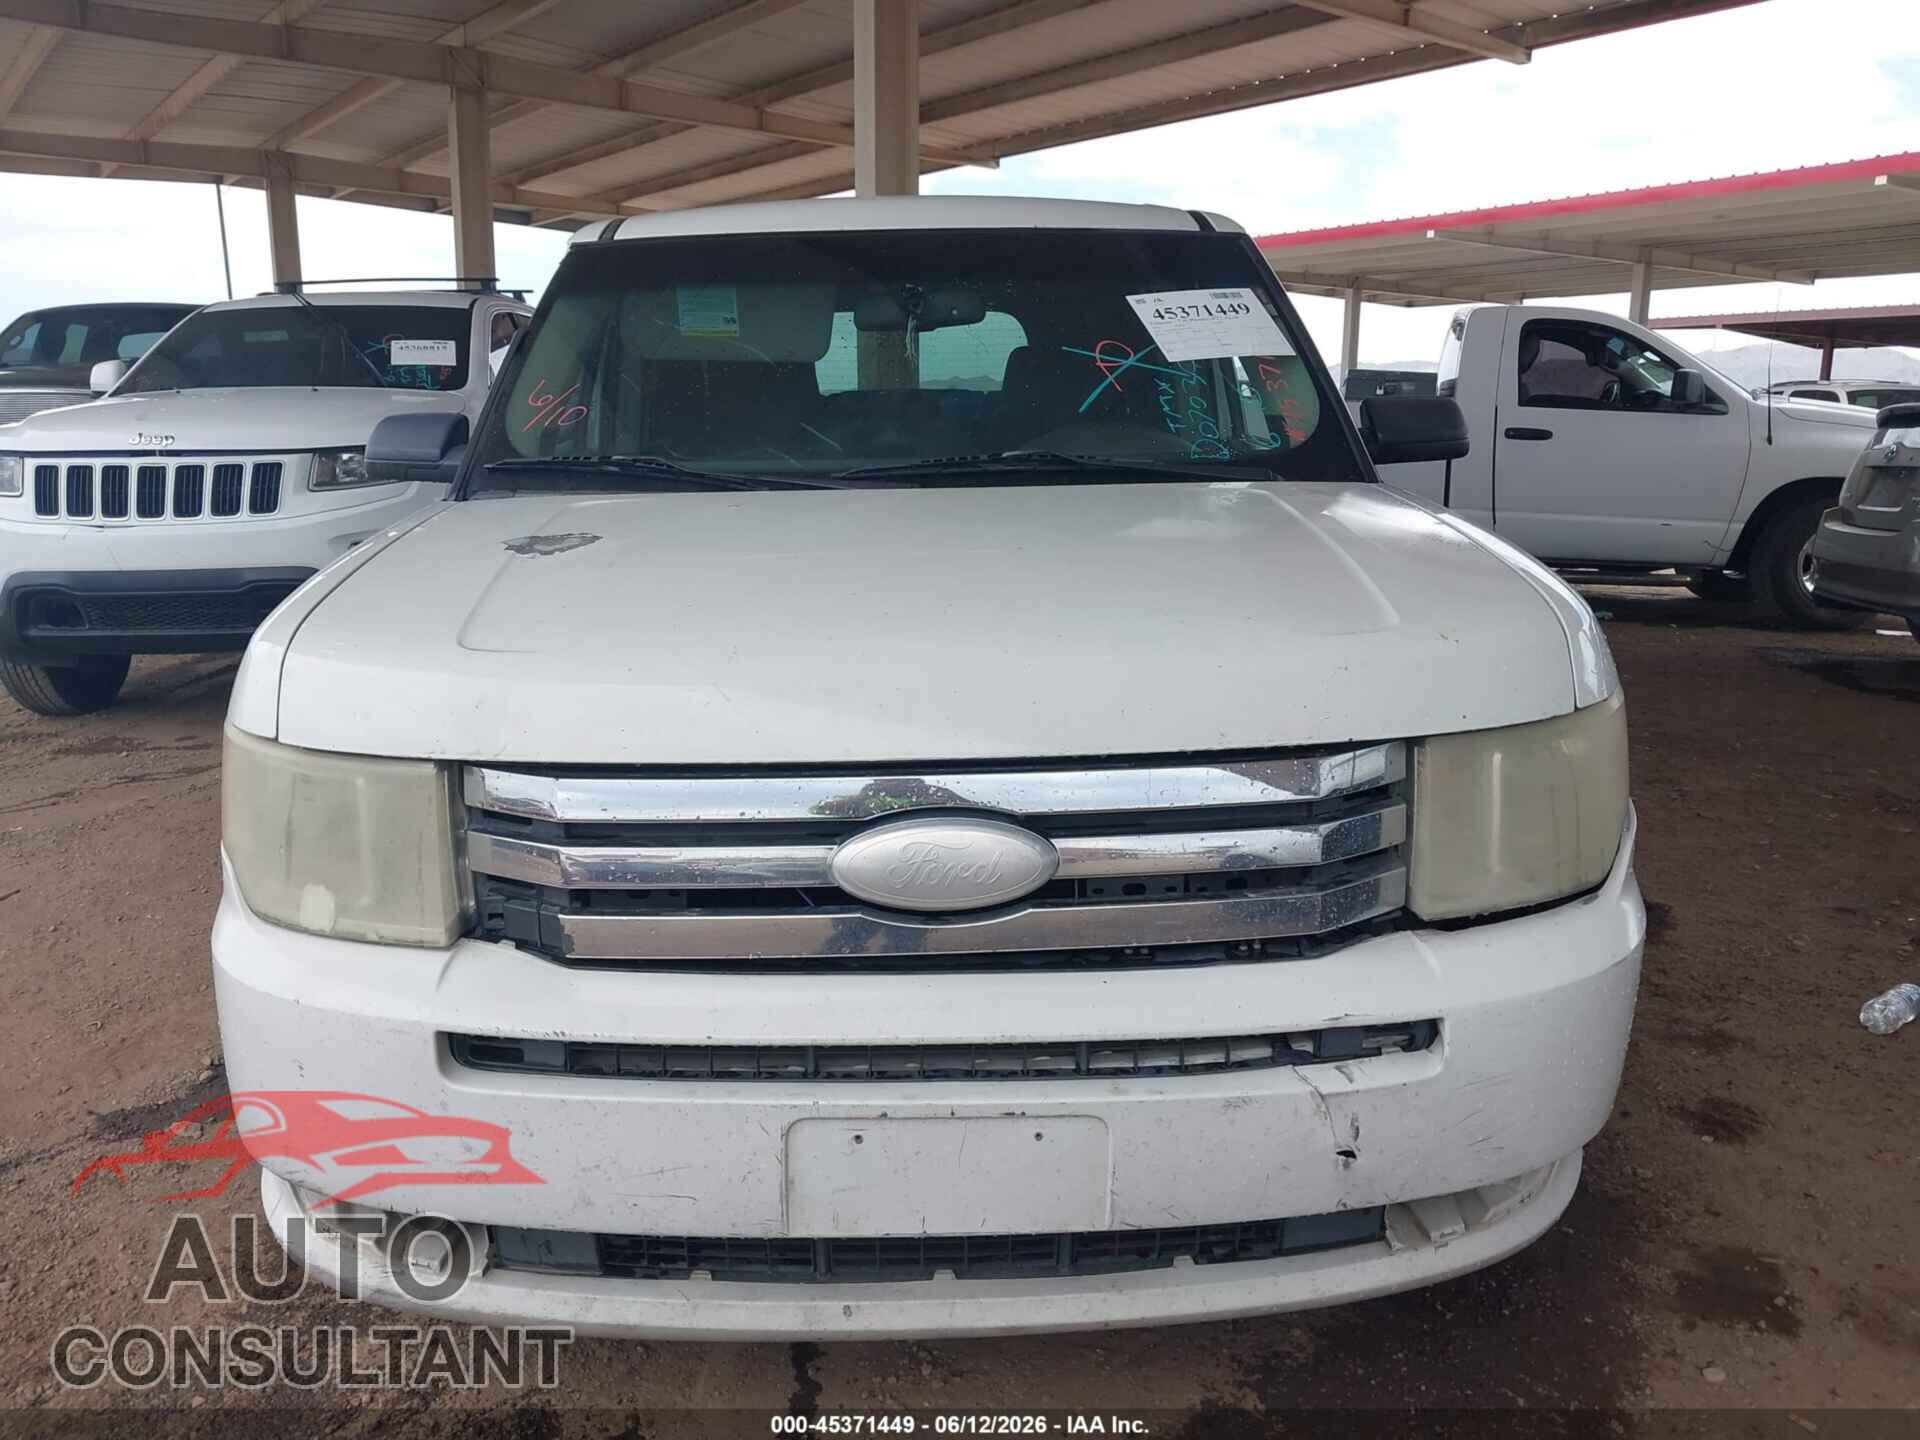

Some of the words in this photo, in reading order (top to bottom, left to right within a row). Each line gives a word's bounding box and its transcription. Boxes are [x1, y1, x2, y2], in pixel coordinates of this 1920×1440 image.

[1152, 302, 1251, 320] 45371449
[521, 377, 589, 433] 6/10
[128, 432, 176, 448] Jeep
[887, 840, 1002, 889] Ford
